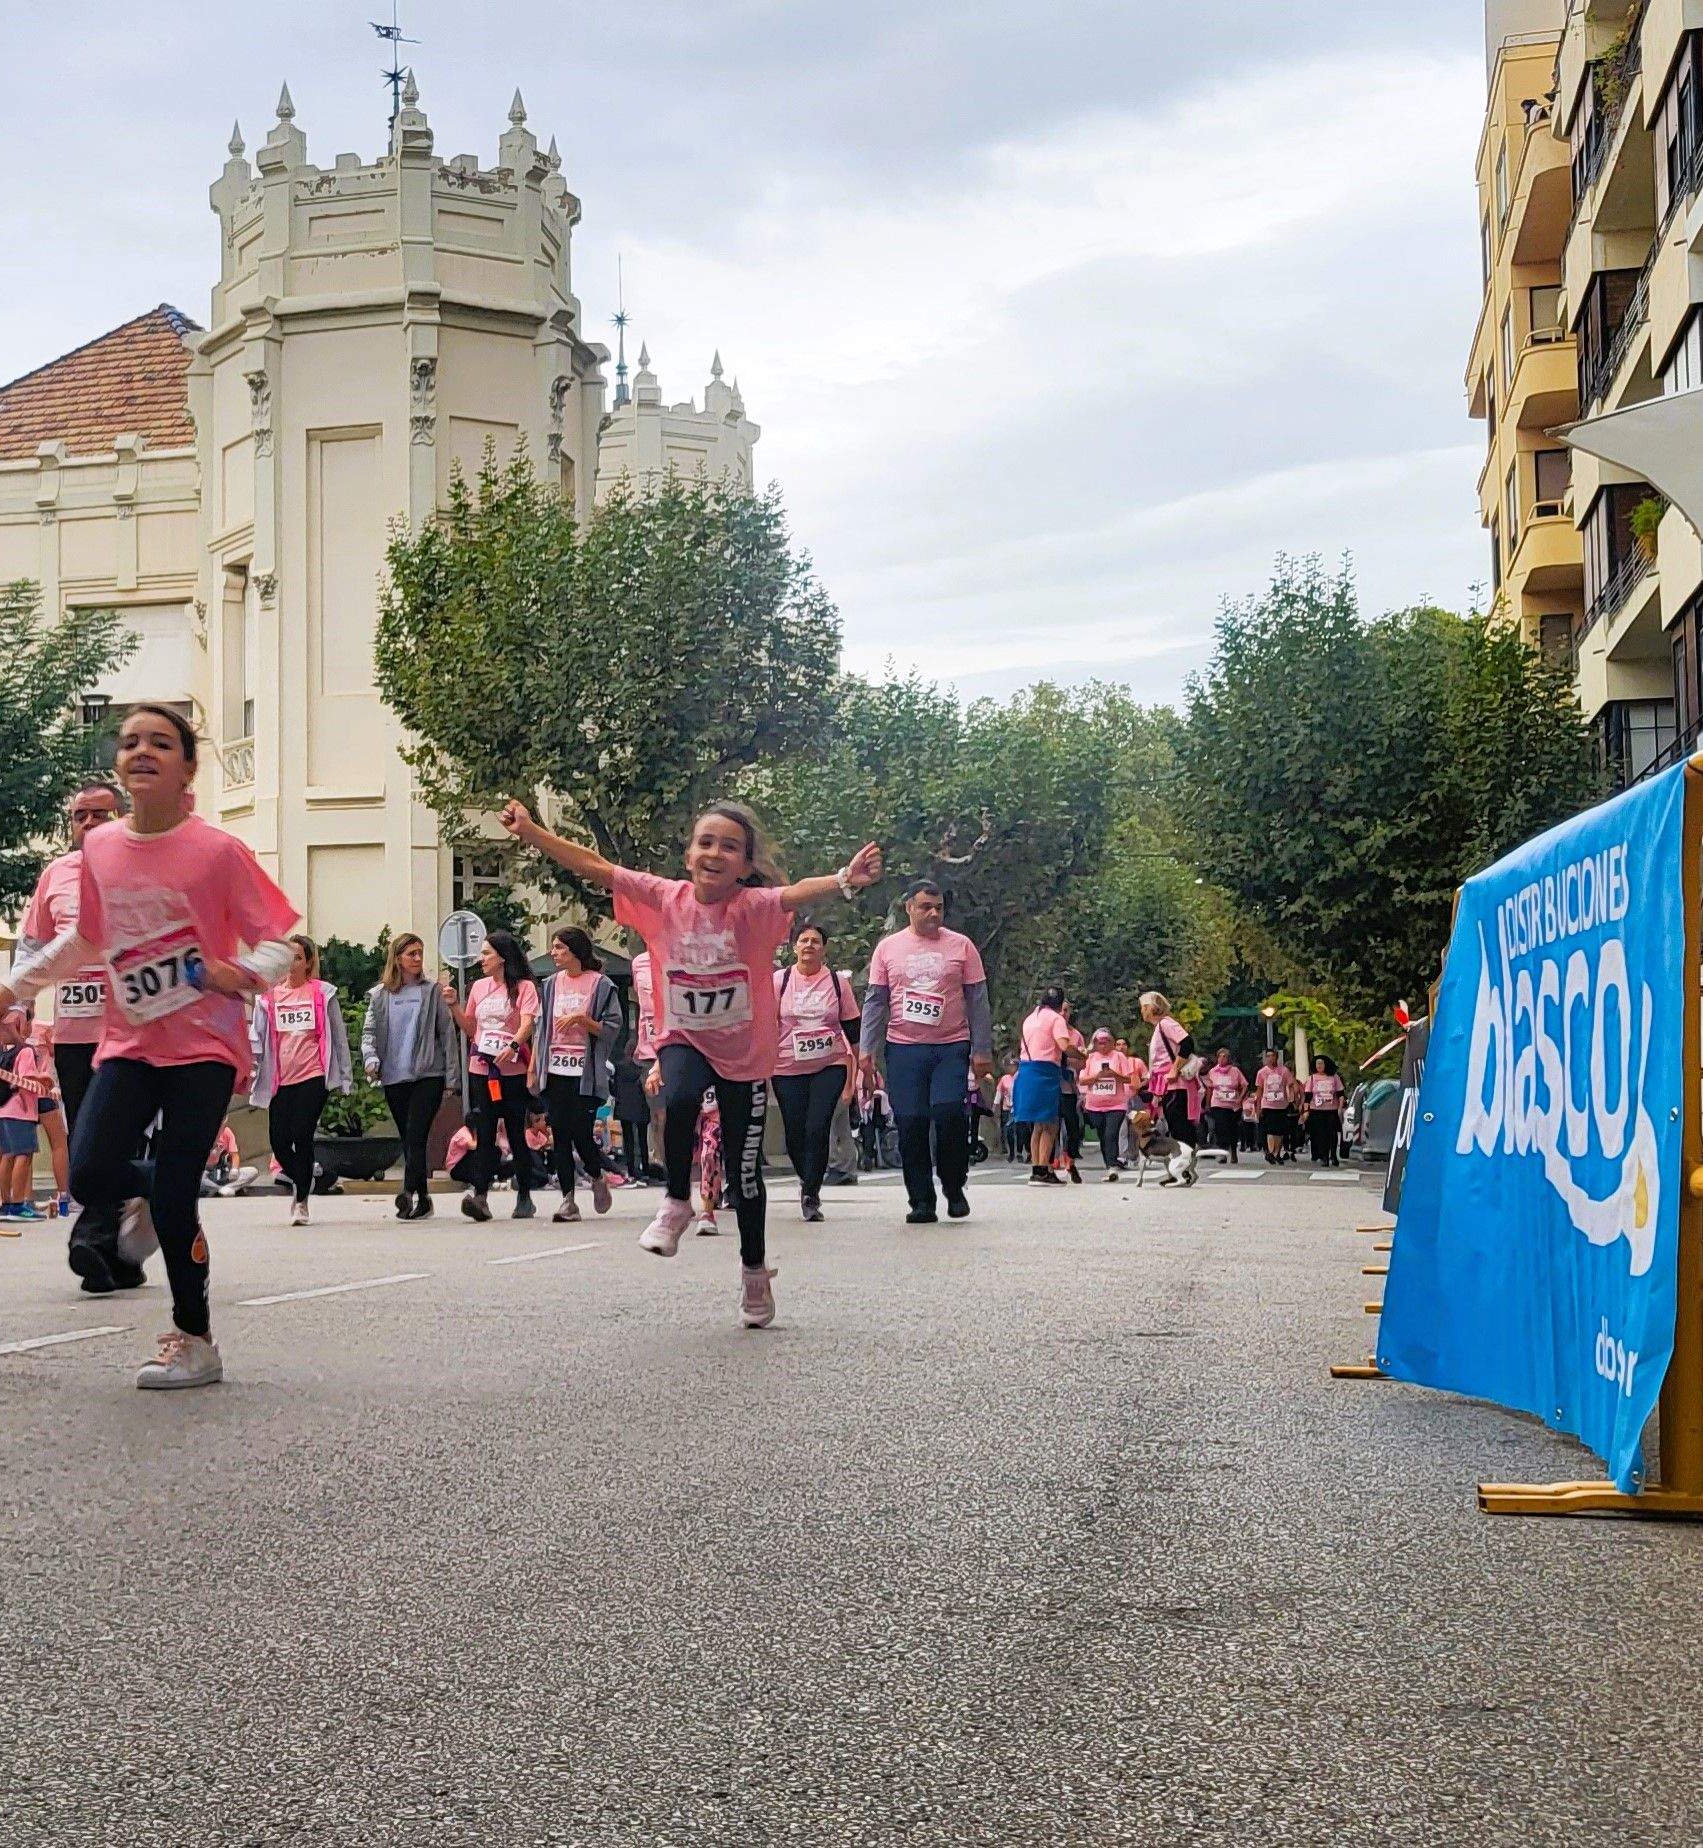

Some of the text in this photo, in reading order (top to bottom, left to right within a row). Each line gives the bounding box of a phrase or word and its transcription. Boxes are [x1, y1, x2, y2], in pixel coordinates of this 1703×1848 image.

[683, 986, 737, 1014] 177
[280, 1011, 312, 1024] 1852
[905, 1000, 941, 1018] 2955
[798, 1037, 834, 1053] 2954
